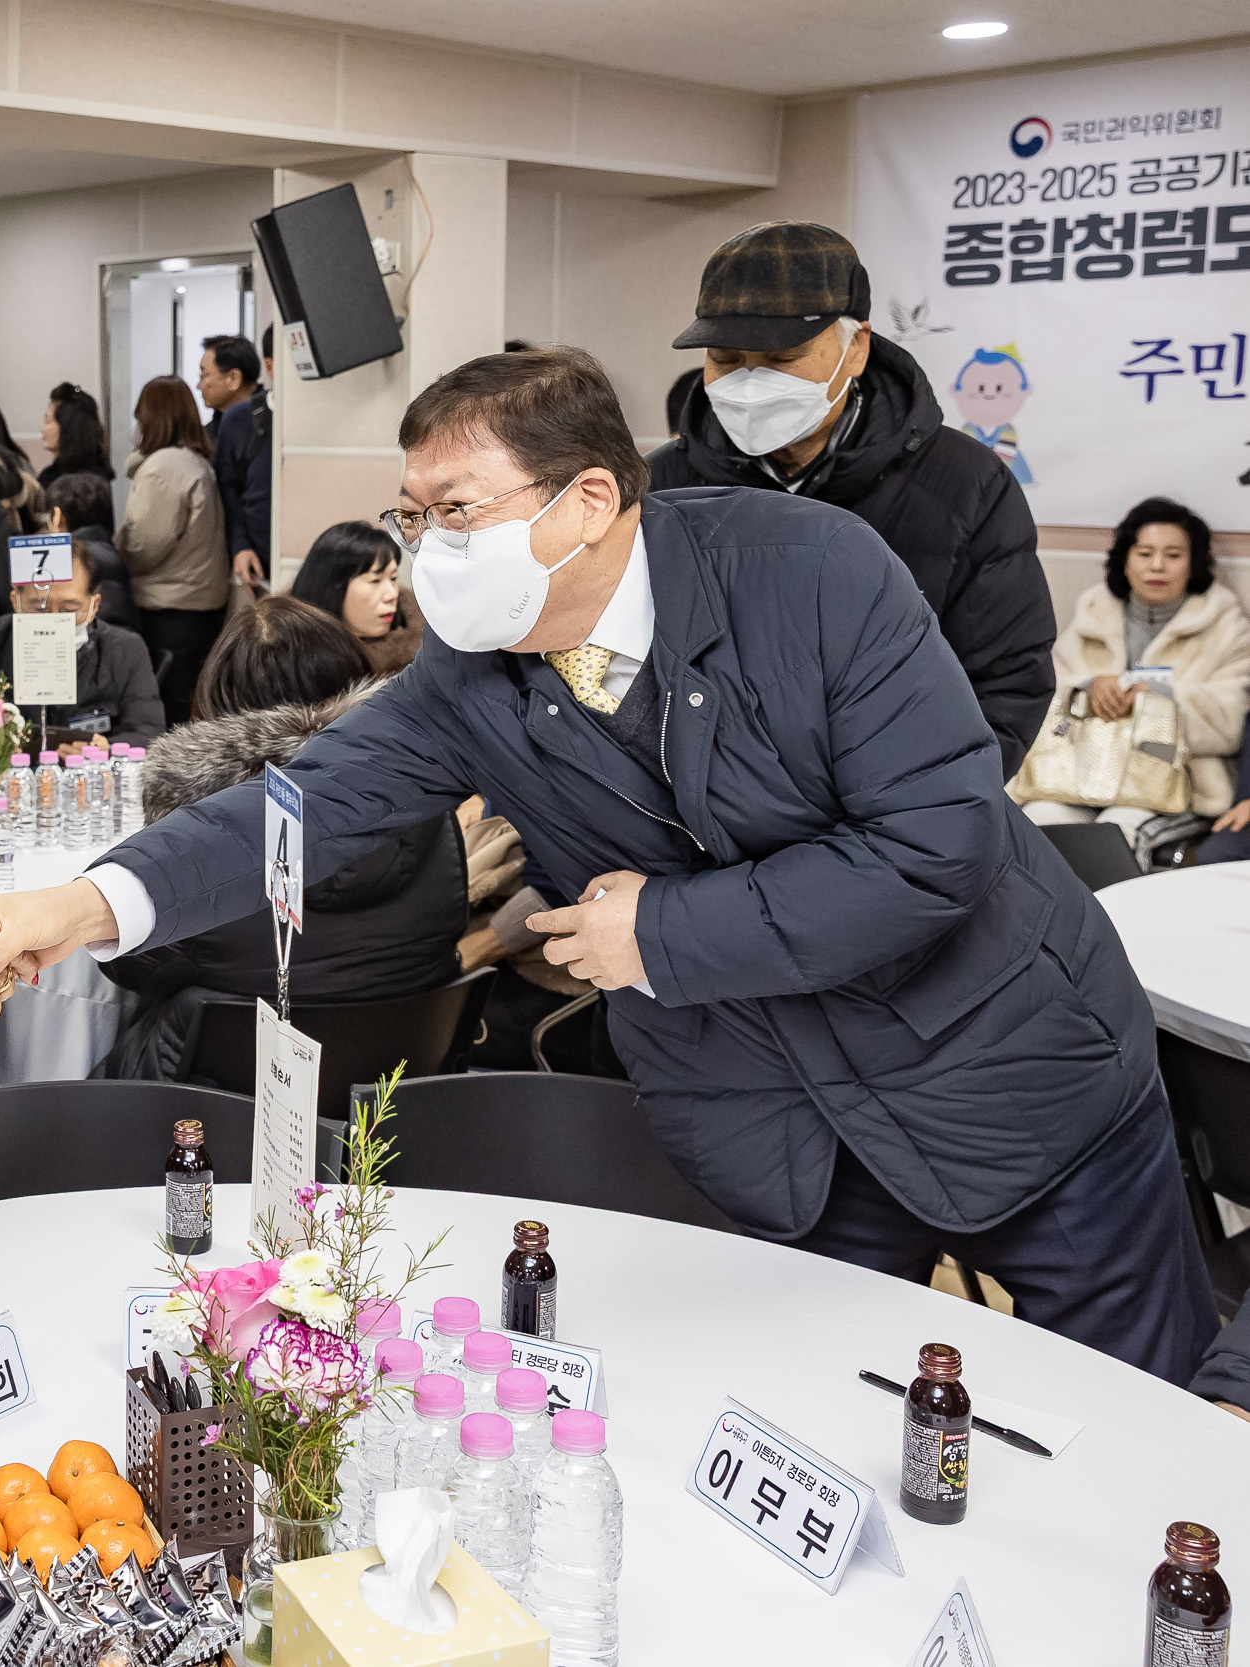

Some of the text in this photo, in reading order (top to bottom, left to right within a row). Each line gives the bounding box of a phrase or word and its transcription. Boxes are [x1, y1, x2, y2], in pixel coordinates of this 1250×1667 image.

[1061, 106, 1223, 144] 국민권익위원회
[953, 162, 1118, 210] 2023-2025
[31, 549, 50, 576] 7
[526, 1352, 558, 1372] 경로당
[561, 1362, 585, 1379] 회장
[786, 1463, 817, 1492] 경로당
[817, 1485, 841, 1508] 회장
